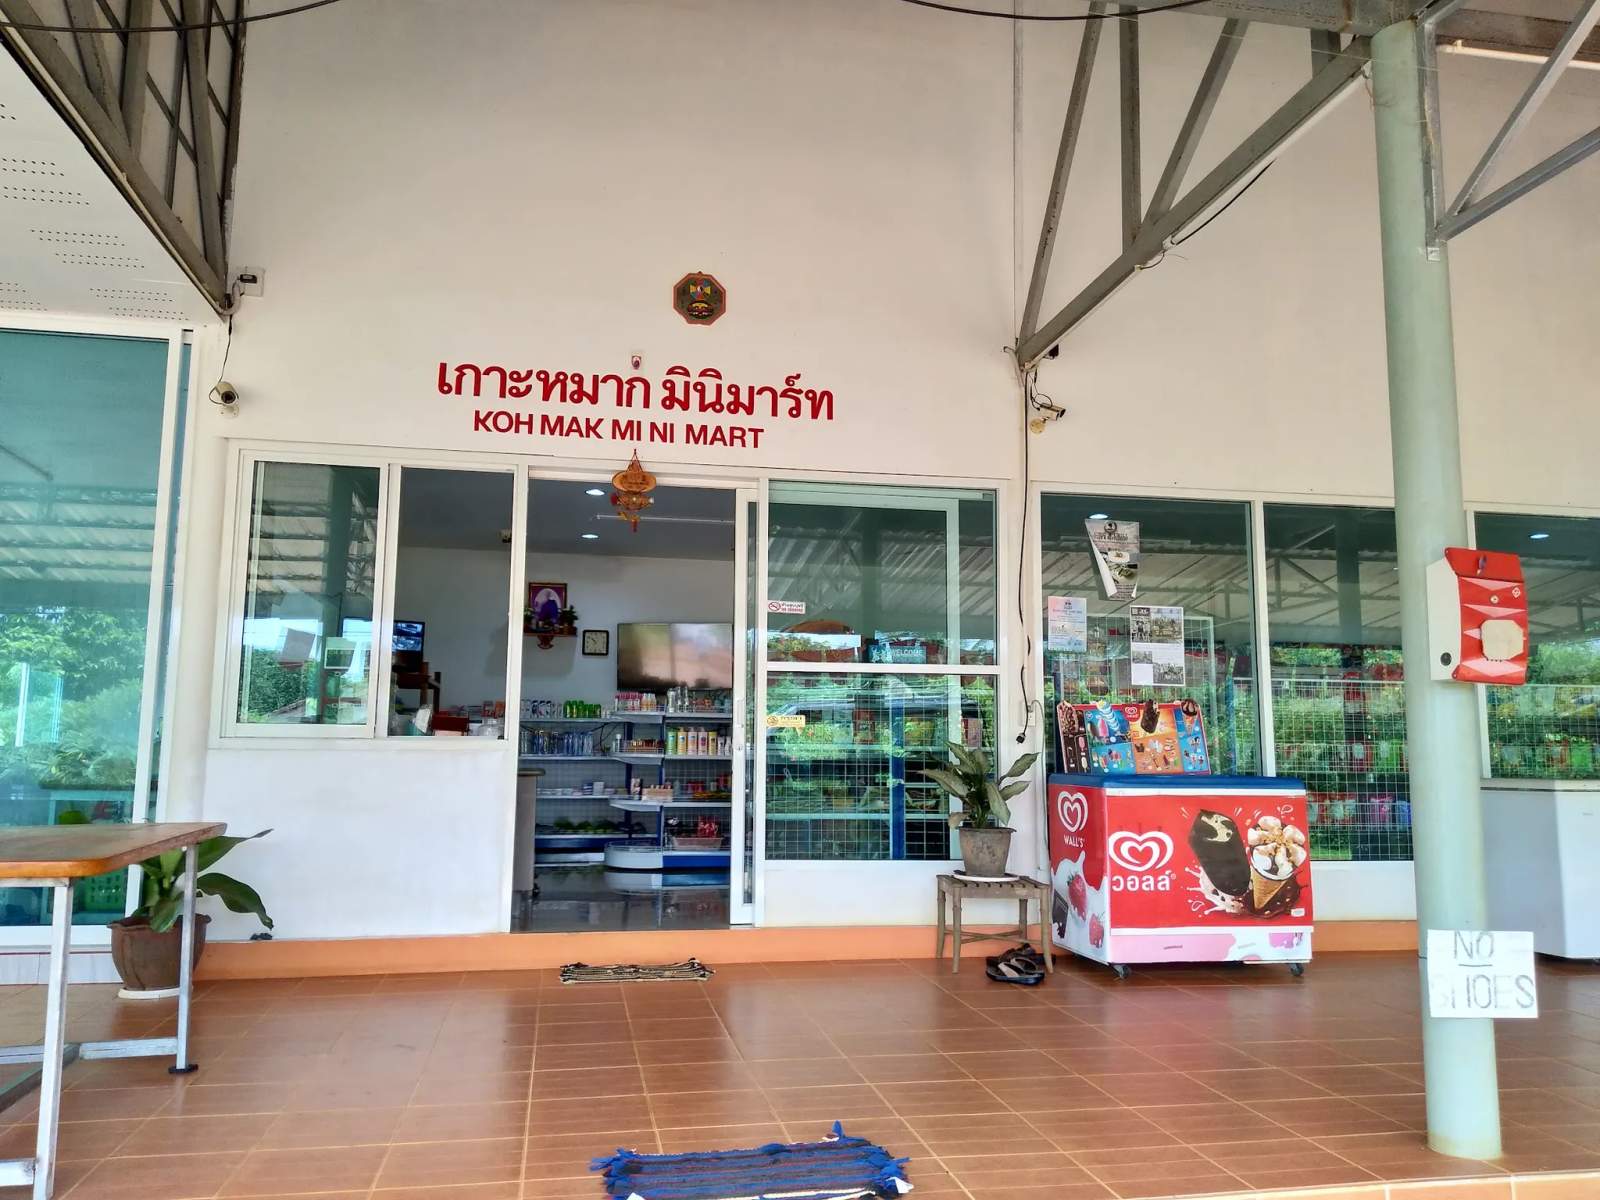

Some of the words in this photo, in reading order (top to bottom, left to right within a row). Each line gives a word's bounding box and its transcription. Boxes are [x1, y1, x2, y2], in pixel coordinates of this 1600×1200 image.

[437, 362, 651, 409] เกาะหมาก
[661, 364, 834, 421] มินิมาร์ท
[474, 409, 534, 435] KOH
[540, 414, 604, 440] MAK
[685, 423, 765, 449] MART
[1064, 835, 1084, 848] WALL'S
[1112, 870, 1172, 892] วอลล์
[1454, 930, 1495, 959] NO
